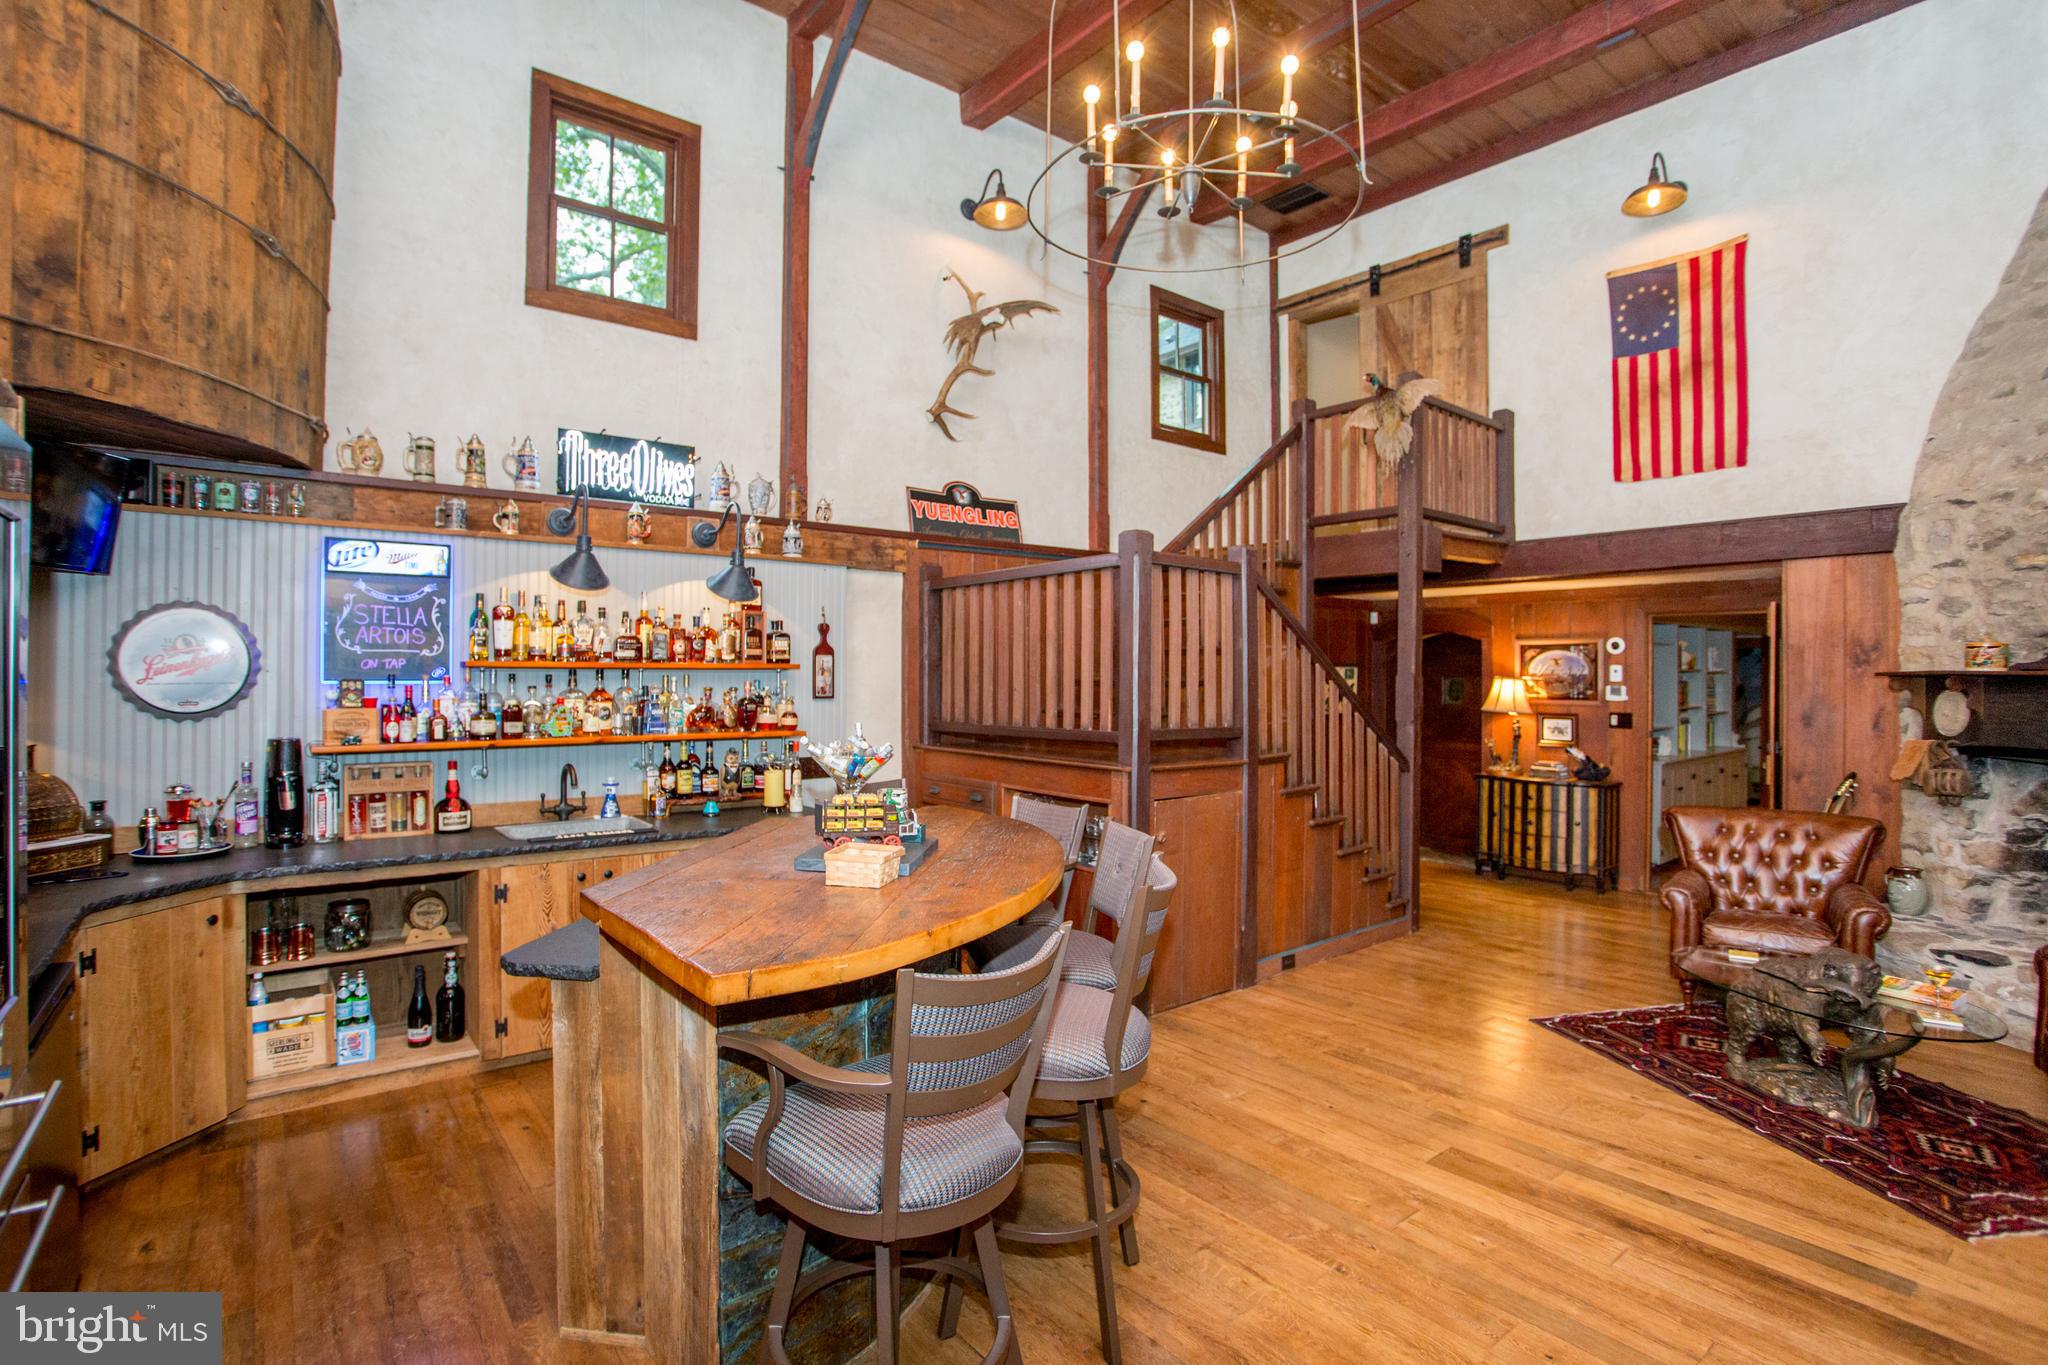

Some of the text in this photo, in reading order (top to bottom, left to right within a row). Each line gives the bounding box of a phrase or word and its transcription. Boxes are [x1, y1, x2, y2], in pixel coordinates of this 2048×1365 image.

[558, 429, 695, 498] Three Olives
[643, 494, 674, 505] VODKA
[911, 499, 1019, 528] YUENGLING
[331, 544, 375, 567] Lite
[386, 552, 419, 565] Miller
[352, 603, 428, 627] STELLA
[354, 625, 427, 645] ARTOIS
[360, 657, 407, 670] ON TAP
